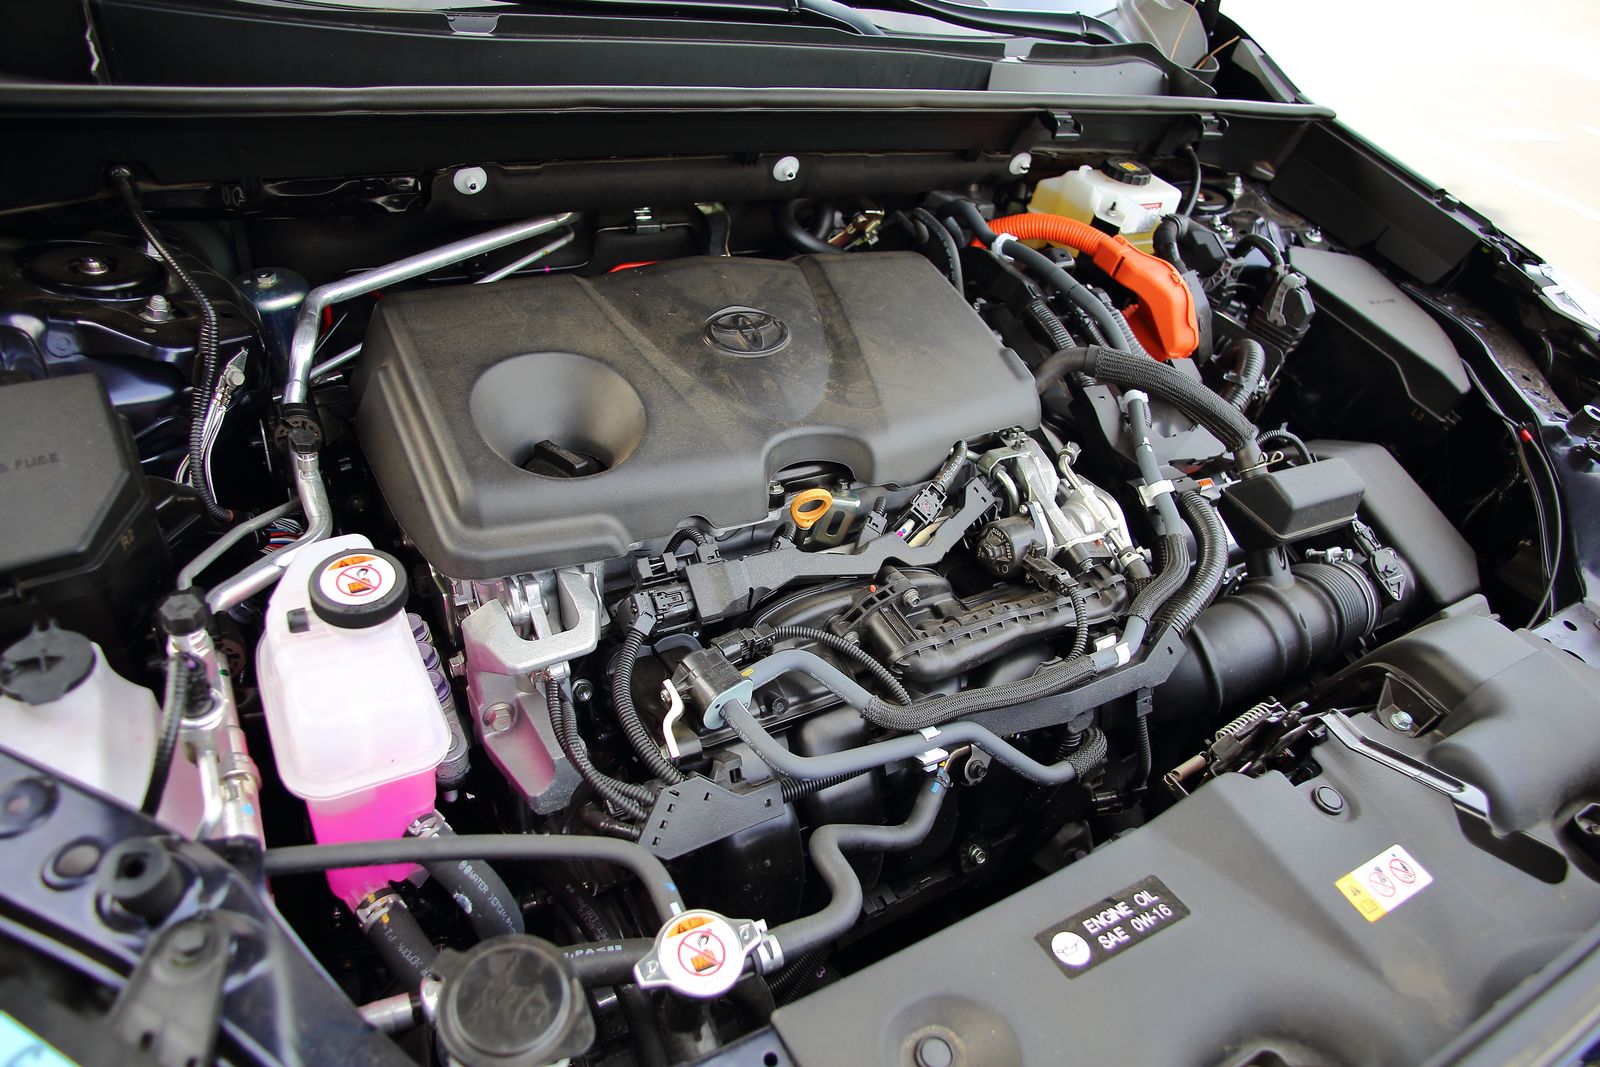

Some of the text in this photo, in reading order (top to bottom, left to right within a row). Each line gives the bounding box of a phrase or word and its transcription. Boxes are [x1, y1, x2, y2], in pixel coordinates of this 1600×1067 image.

[14, 452, 59, 469] FUSE
[1082, 889, 1160, 934] ENGINE OIL
[1097, 903, 1172, 949] SAE 0W-16
